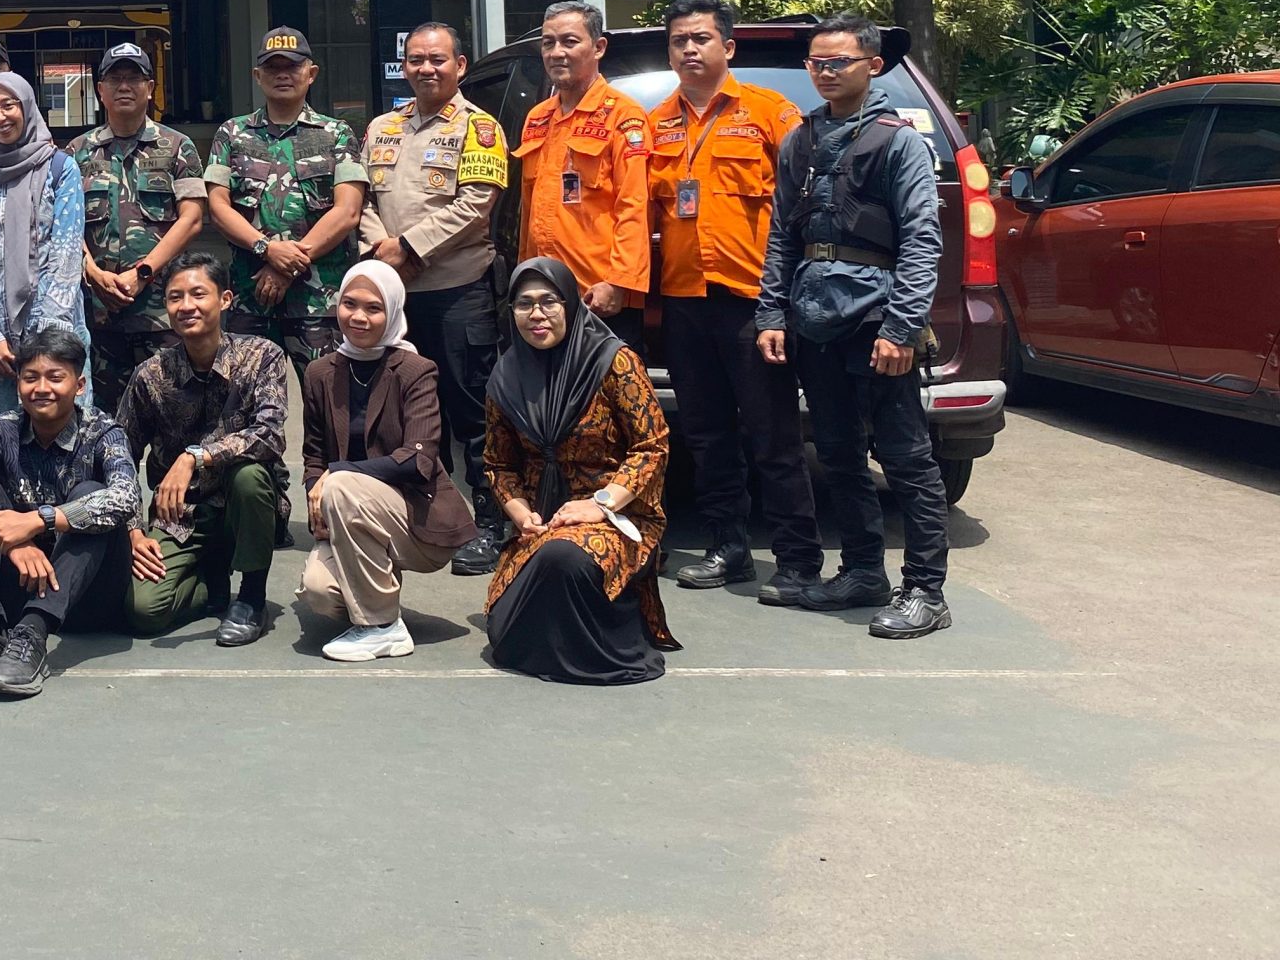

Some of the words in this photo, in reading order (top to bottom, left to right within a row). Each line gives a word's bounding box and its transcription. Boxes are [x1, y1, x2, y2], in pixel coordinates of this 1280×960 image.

[265, 35, 297, 50] 0610
[575, 126, 607, 137] BPBD
[375, 136, 403, 146] TAUFIK
[429, 137, 459, 148] POLRI
